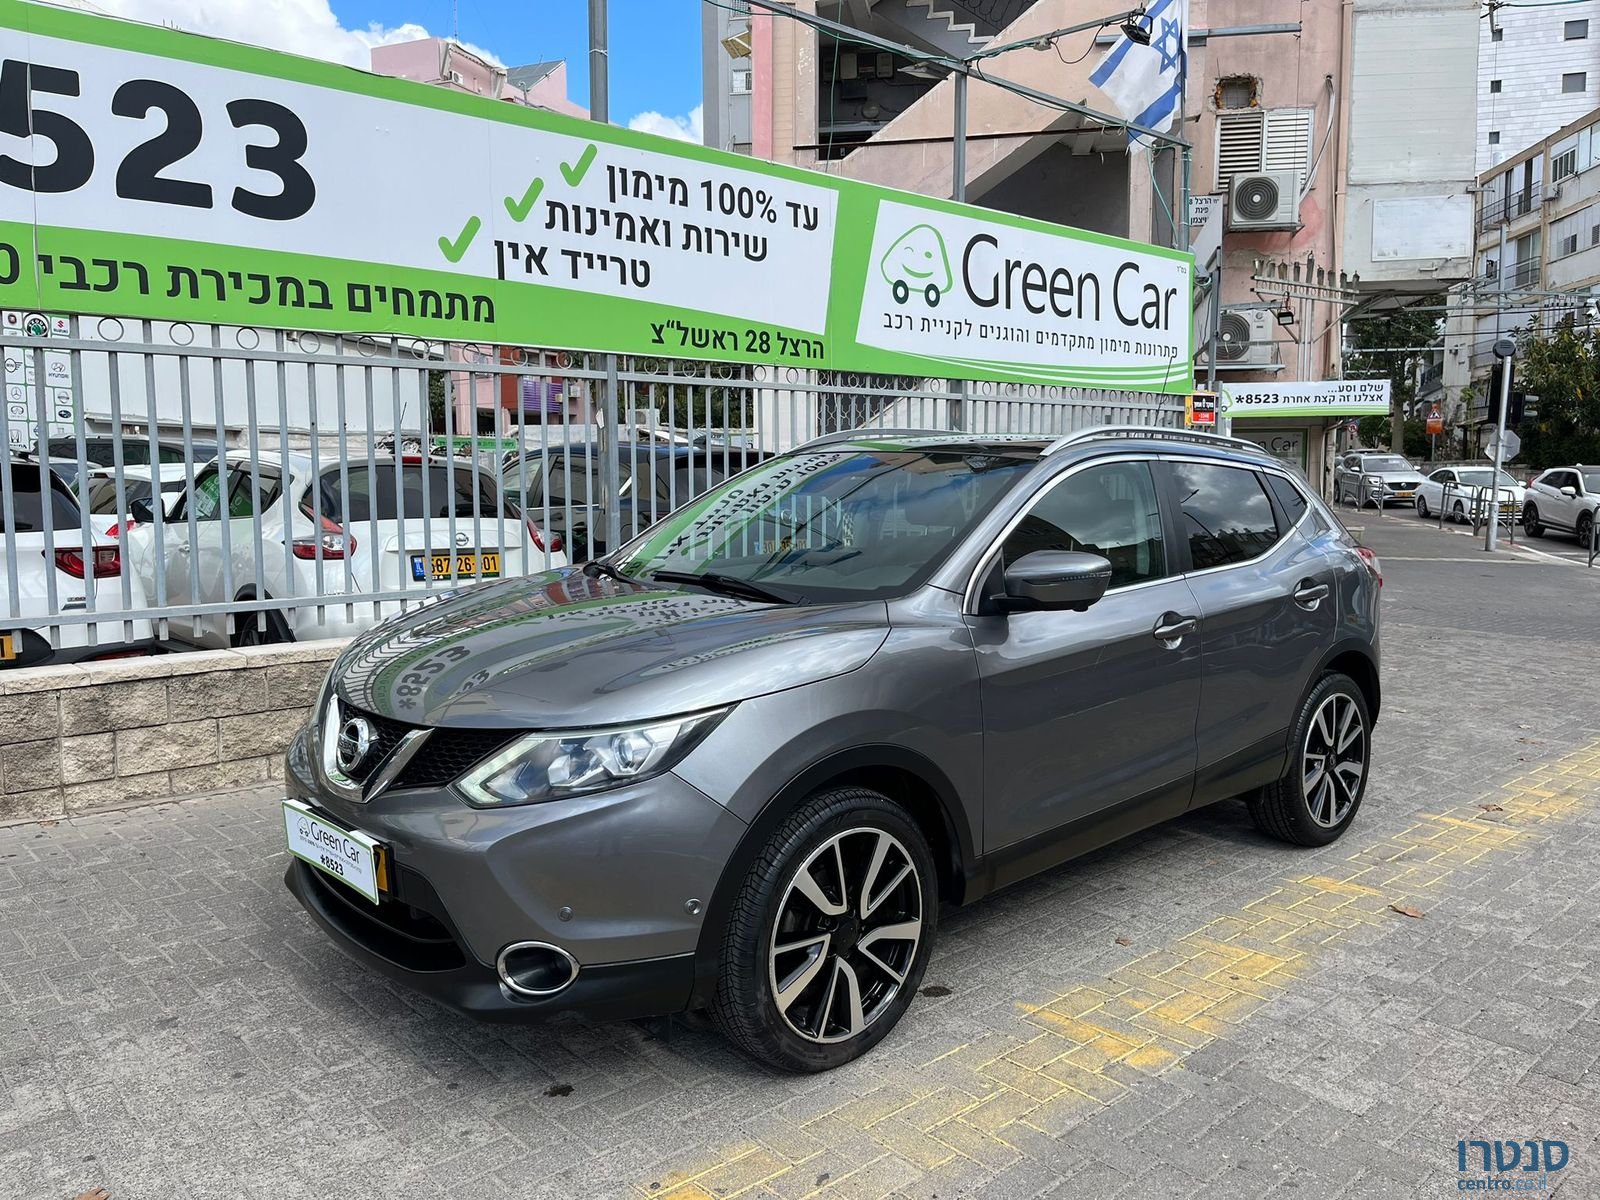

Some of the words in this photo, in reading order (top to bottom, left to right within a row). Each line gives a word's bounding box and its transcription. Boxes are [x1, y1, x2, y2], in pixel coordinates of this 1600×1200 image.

[0, 59, 316, 221] 523
[606, 165, 688, 207] מימון
[700, 181, 777, 223] 100%
[544, 200, 671, 247] ואמינות
[786, 201, 819, 232] עד
[682, 223, 768, 262] שירות
[494, 240, 549, 280] אין
[561, 248, 651, 288] טרייד
[38, 254, 149, 294] רכבי
[167, 265, 333, 310] במכירת
[962, 233, 1101, 322] Green
[1112, 261, 1177, 331] Car
[347, 284, 495, 324] מתמחים
[883, 313, 914, 331] רכב
[920, 317, 972, 341] לקניית
[979, 325, 1030, 344] והוגנים
[745, 329, 771, 353] 28
[776, 332, 824, 359] הרצל
[1036, 331, 1094, 351] מתקדמים
[1100, 337, 1131, 356] מימון
[1135, 341, 1178, 359] פתרונות
[1282, 394, 1311, 404] אחרת
[1313, 394, 1336, 405] קצת
[1339, 394, 1351, 403] זה
[1354, 393, 1383, 403] אצלנו
[1360, 383, 1384, 392] שלם
[1271, 436, 1298, 452] Car
[311, 822, 342, 853] Green
[343, 839, 360, 864] Car
